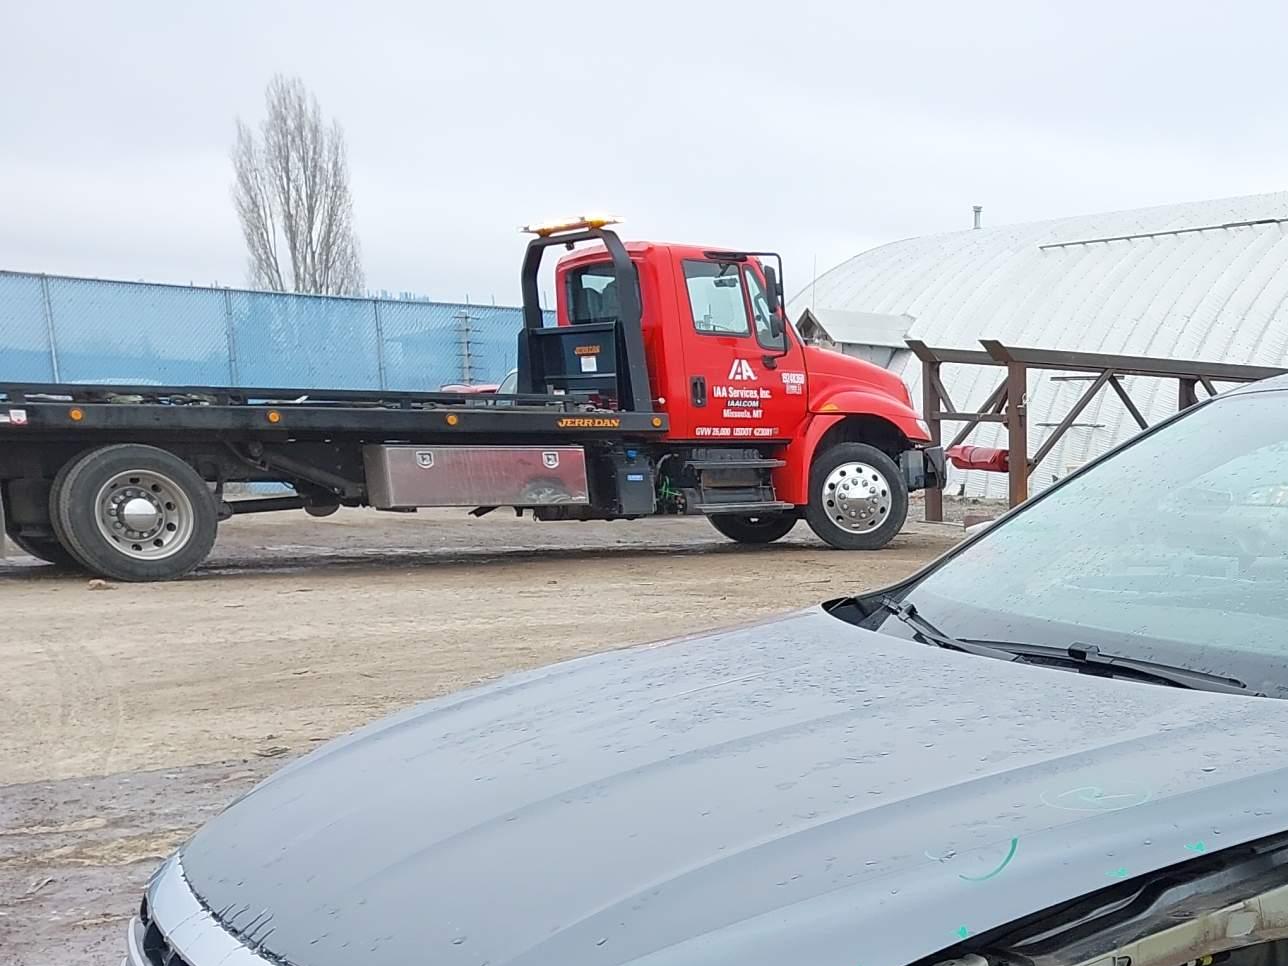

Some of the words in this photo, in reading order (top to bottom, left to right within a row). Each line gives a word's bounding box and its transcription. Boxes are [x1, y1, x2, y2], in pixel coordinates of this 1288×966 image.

[713, 386, 727, 398] IAA
[728, 387, 759, 399] Services,
[760, 387, 772, 399] Inc.
[752, 410, 763, 418] MT
